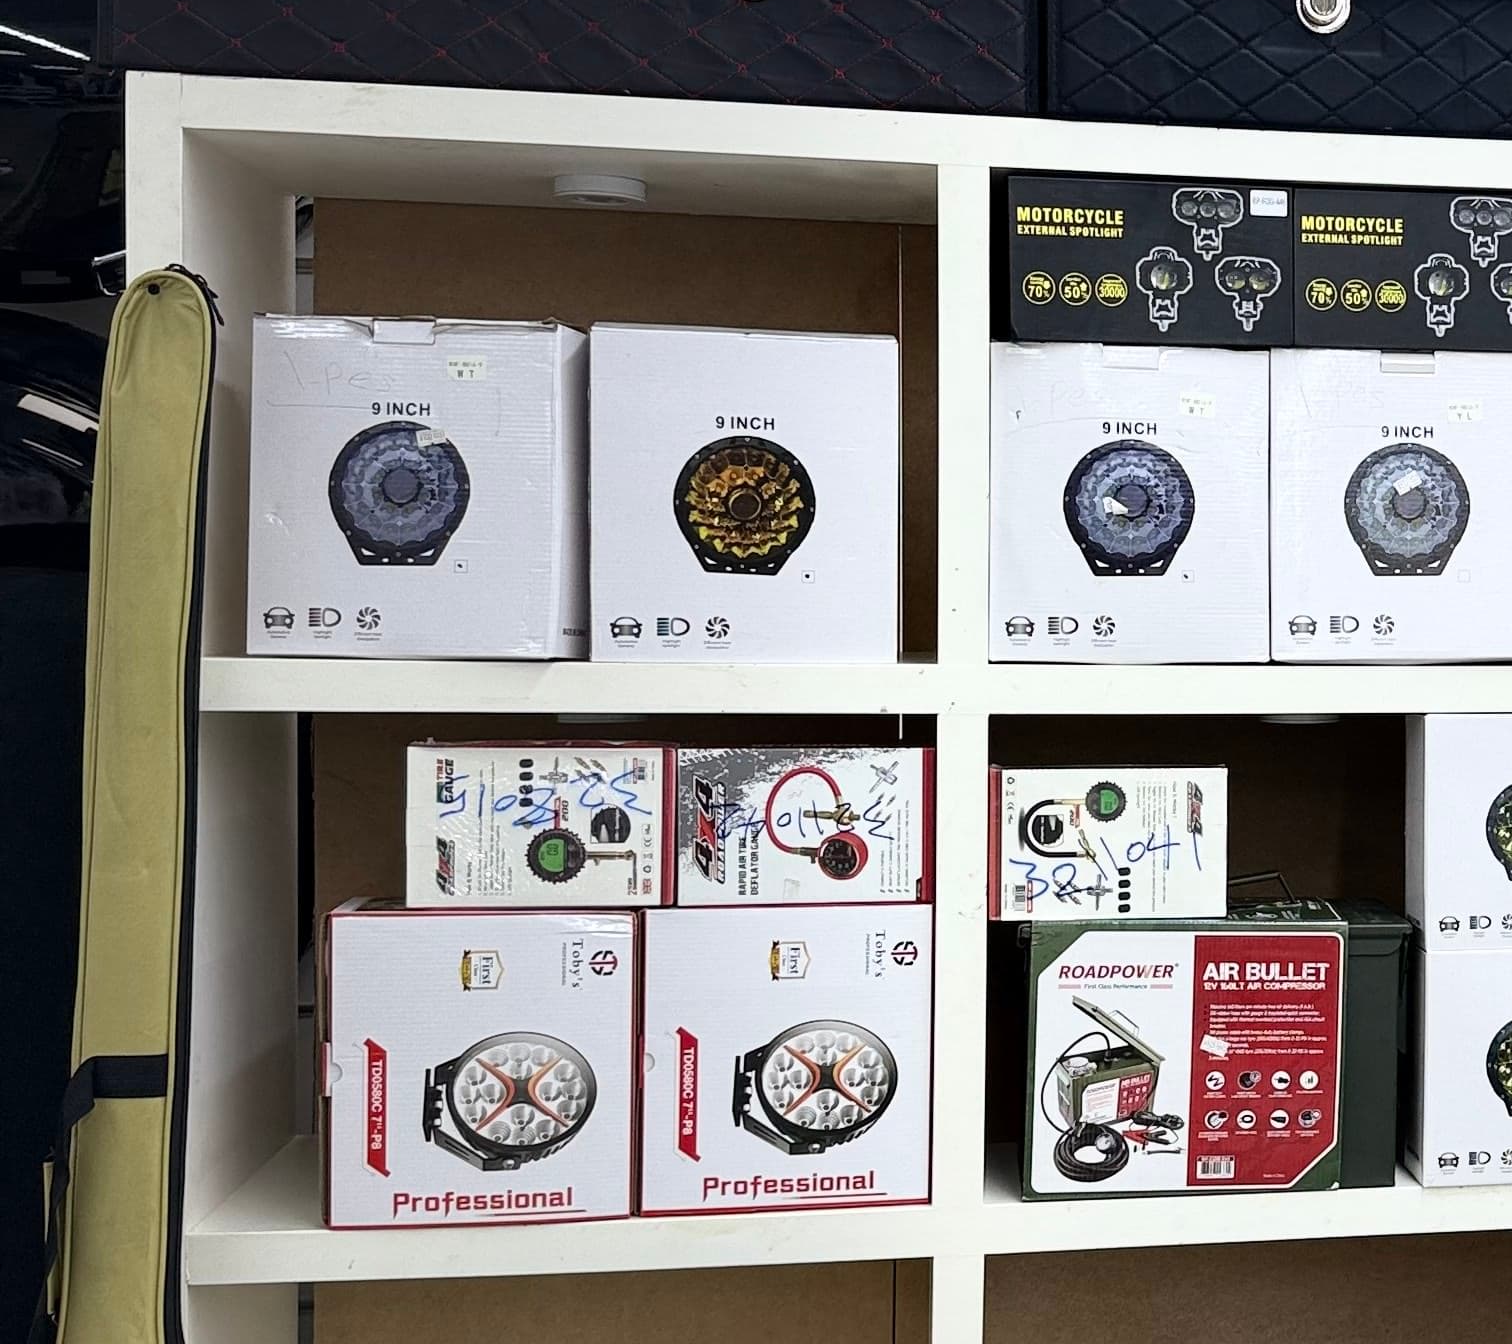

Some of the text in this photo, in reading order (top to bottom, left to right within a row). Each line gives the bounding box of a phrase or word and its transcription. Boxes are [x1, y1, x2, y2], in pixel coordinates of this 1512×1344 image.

[1016, 206, 1124, 226] MOTORCYCLE
[1301, 215, 1404, 233] MOTORCYCLE
[1017, 224, 1124, 239] EXTERNAL SPOTLIGHT
[1301, 233, 1404, 246] EXTERNAL SPOTLIGHT
[371, 402, 431, 417] 9 INCH
[715, 415, 776, 432] 9 INCH
[1102, 421, 1158, 436] 9 INCH
[1381, 425, 1435, 439] 9 INCH
[738, 871, 747, 896] RAPID
[788, 946, 800, 975] First
[874, 929, 886, 979] Toby's
[481, 955, 492, 986] First
[572, 938, 584, 991] Toby's
[1058, 964, 1175, 980] ROADPOWER
[1203, 962, 1330, 981] AIR BULLET
[1264, 982, 1326, 991] COMPRESSOR
[682, 1046, 695, 1100] TD0580C
[371, 1059, 383, 1113] TD0580C
[703, 1170, 876, 1203] Professional
[393, 1187, 573, 1219] Professional
